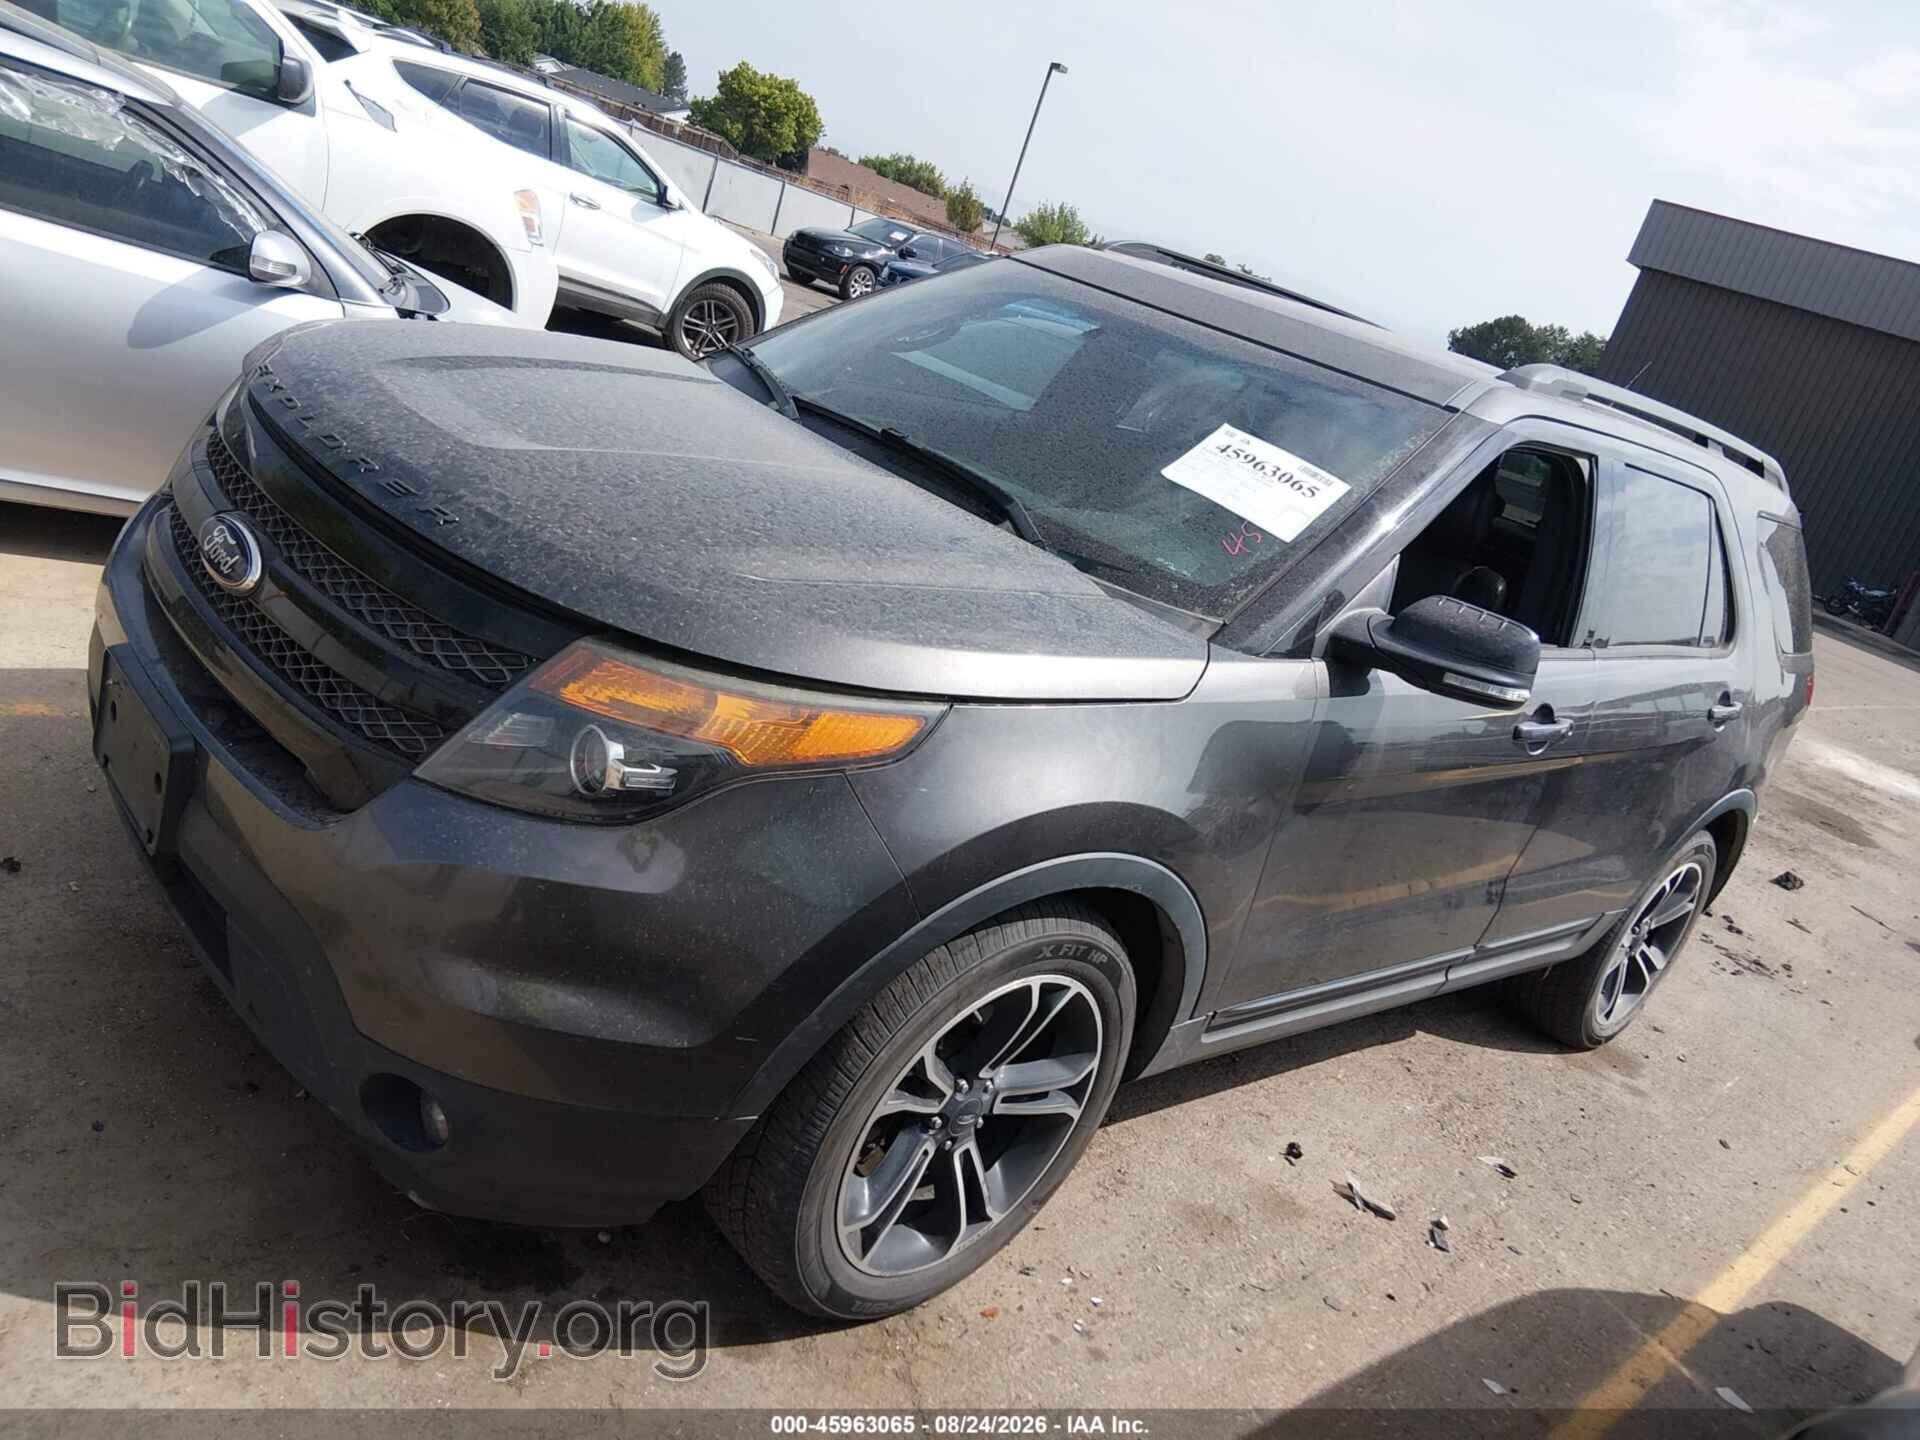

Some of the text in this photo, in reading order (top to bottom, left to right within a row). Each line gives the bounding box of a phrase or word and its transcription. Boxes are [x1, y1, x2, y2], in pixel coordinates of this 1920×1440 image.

[256, 363, 462, 525] EXPLORER
[1216, 444, 1321, 498] 45963065
[204, 525, 240, 574] Ford
[1037, 943, 1108, 964] X FIT HP
